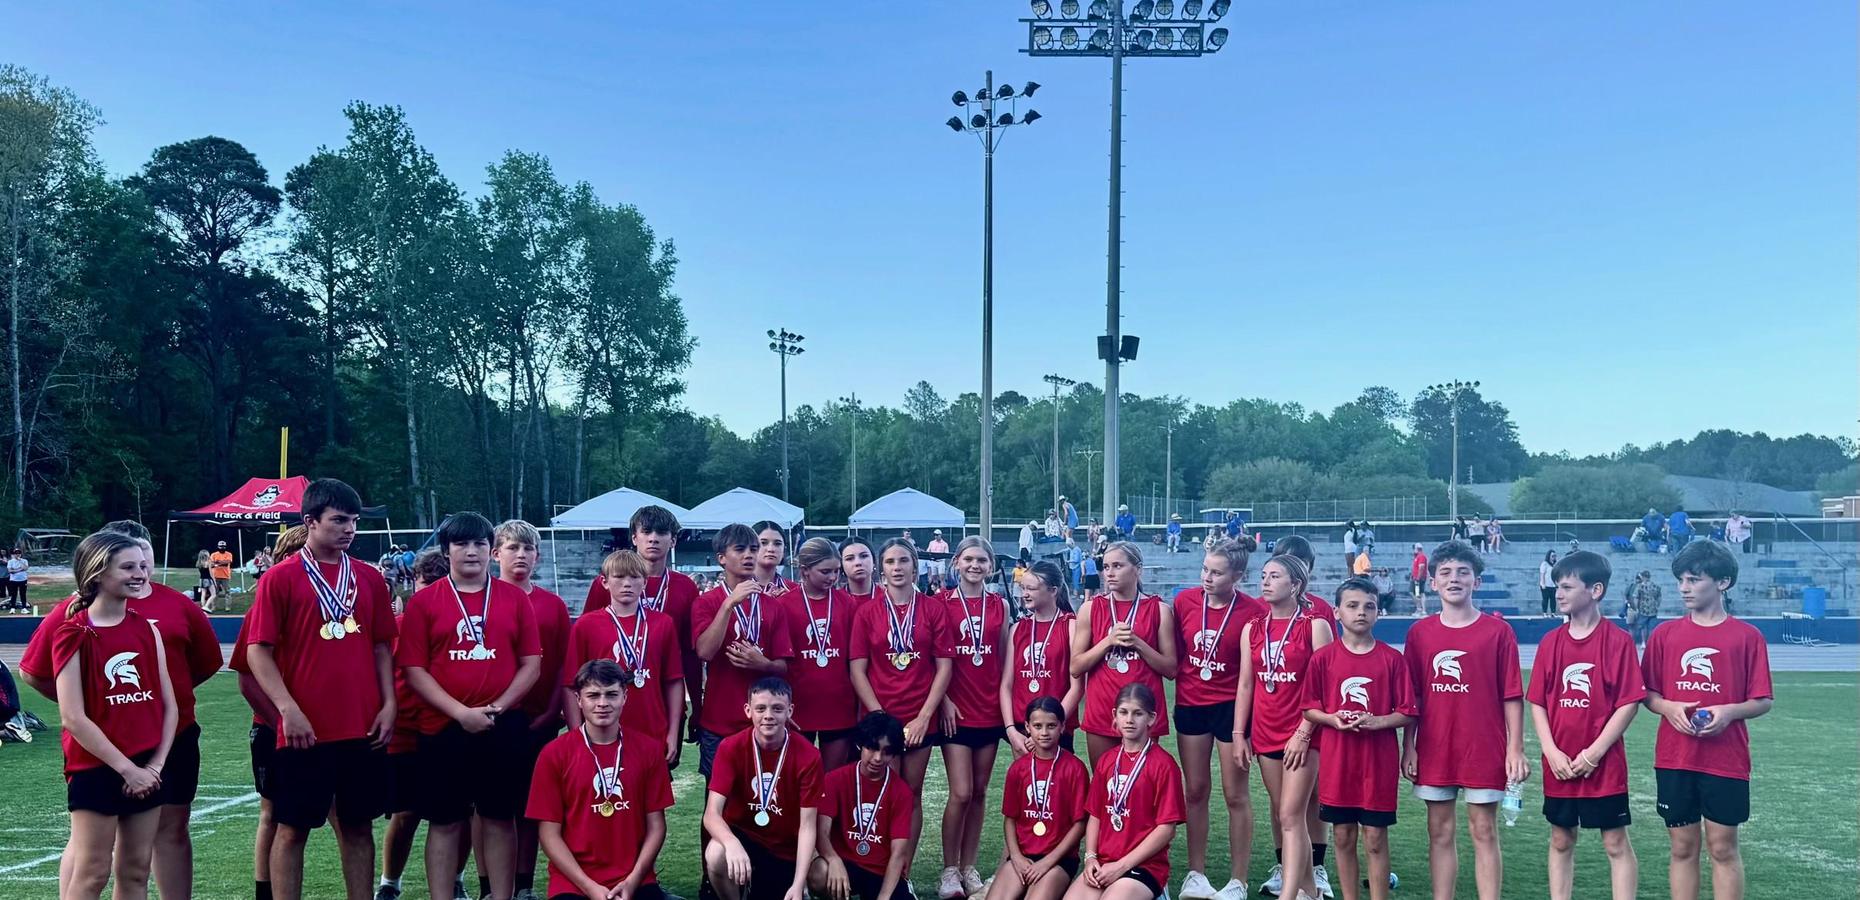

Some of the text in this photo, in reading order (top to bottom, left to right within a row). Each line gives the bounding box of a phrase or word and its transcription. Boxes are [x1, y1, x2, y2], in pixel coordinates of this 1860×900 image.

[448, 649, 496, 661] TRAK
[801, 648, 839, 659] TRCK
[1020, 670, 1052, 678] TRCK
[1256, 671, 1296, 682] TRACK
[1431, 683, 1470, 693] TRACK
[1676, 681, 1721, 693] TRACK
[105, 690, 154, 705] TRACK
[847, 831, 883, 844] TRCK
